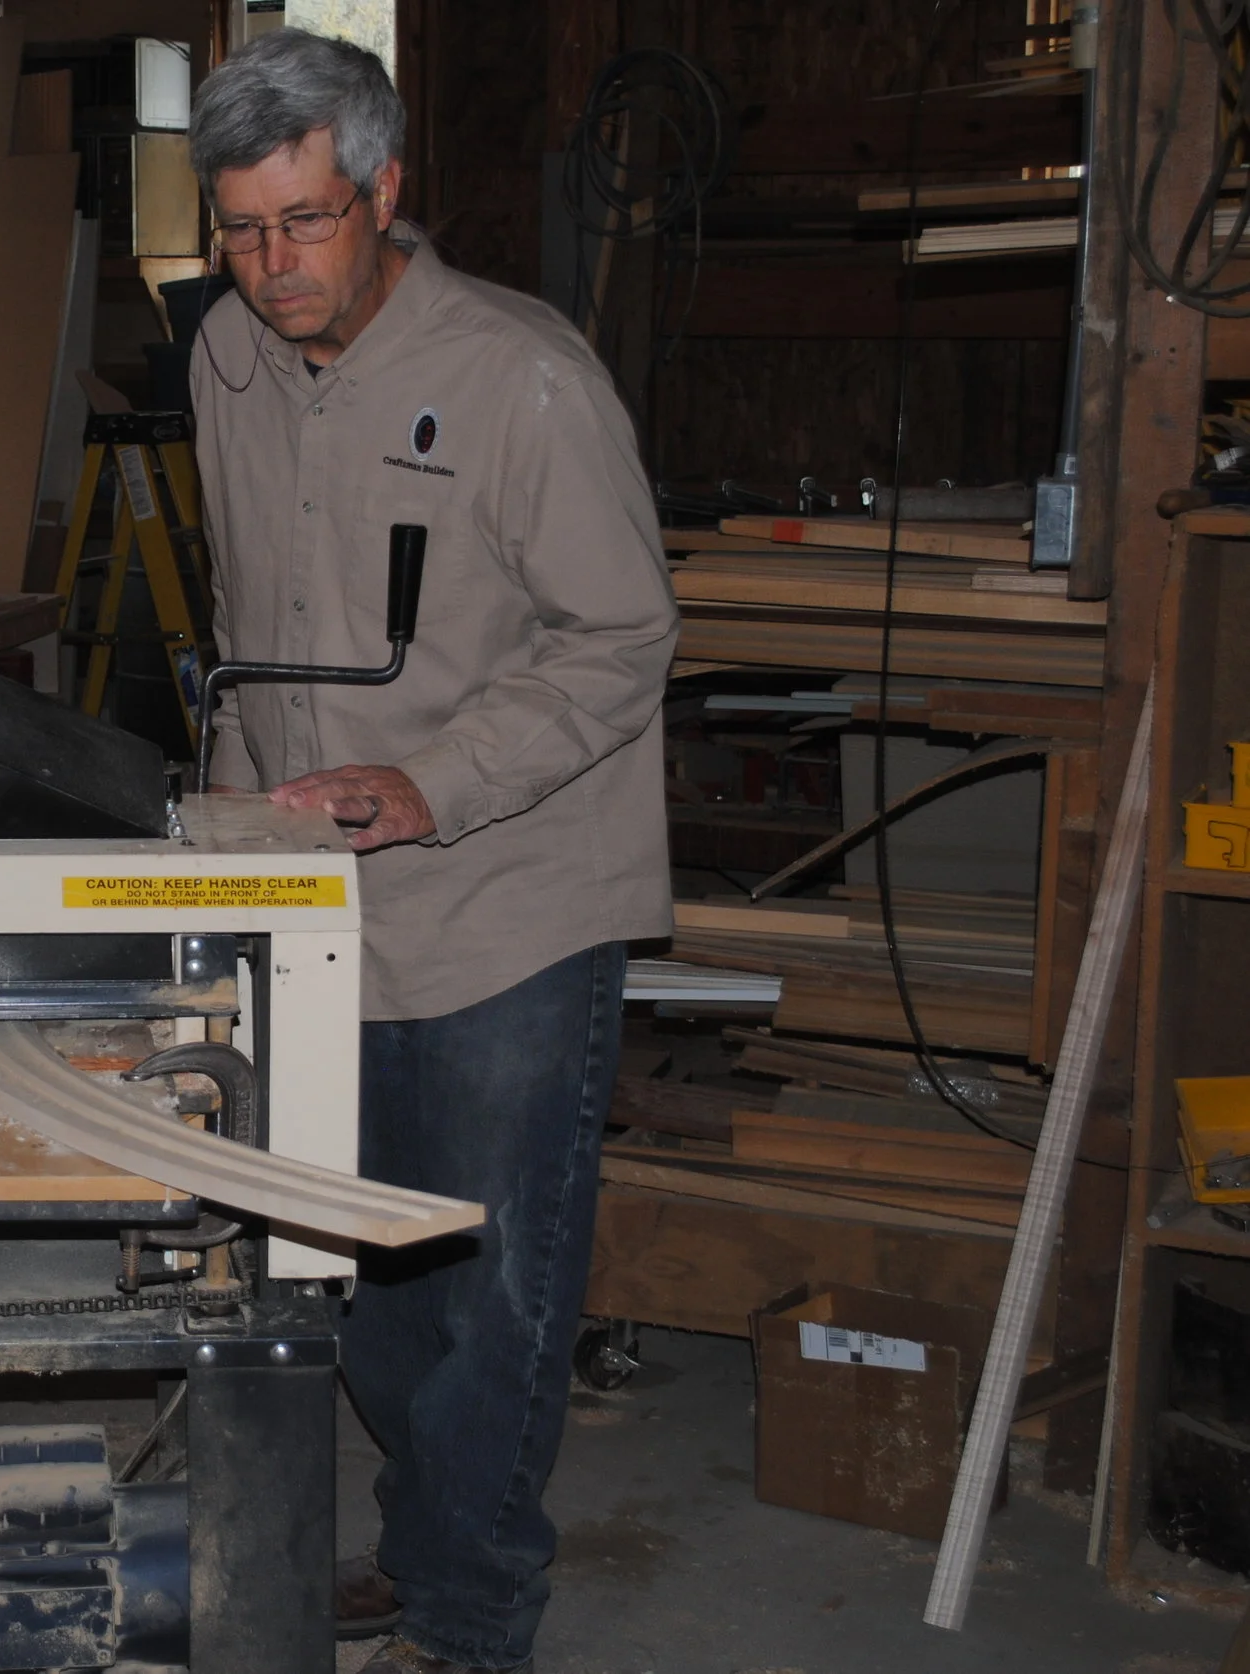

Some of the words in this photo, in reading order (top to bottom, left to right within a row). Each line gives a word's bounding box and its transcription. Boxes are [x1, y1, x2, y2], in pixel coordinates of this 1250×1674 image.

[382, 456, 422, 472] Craftsman
[422, 464, 455, 477] Builders
[86, 878, 158, 889] CAUTION:
[164, 878, 203, 888] KEEP
[209, 878, 262, 888] HANDS
[267, 878, 317, 888] CLEAR
[126, 890, 141, 898] DO
[92, 898, 107, 906] OR
[110, 898, 149, 906] BEHIND
[152, 898, 200, 906] MACHINE
[204, 898, 235, 906] WHEN
[252, 898, 313, 906] OPERATION
